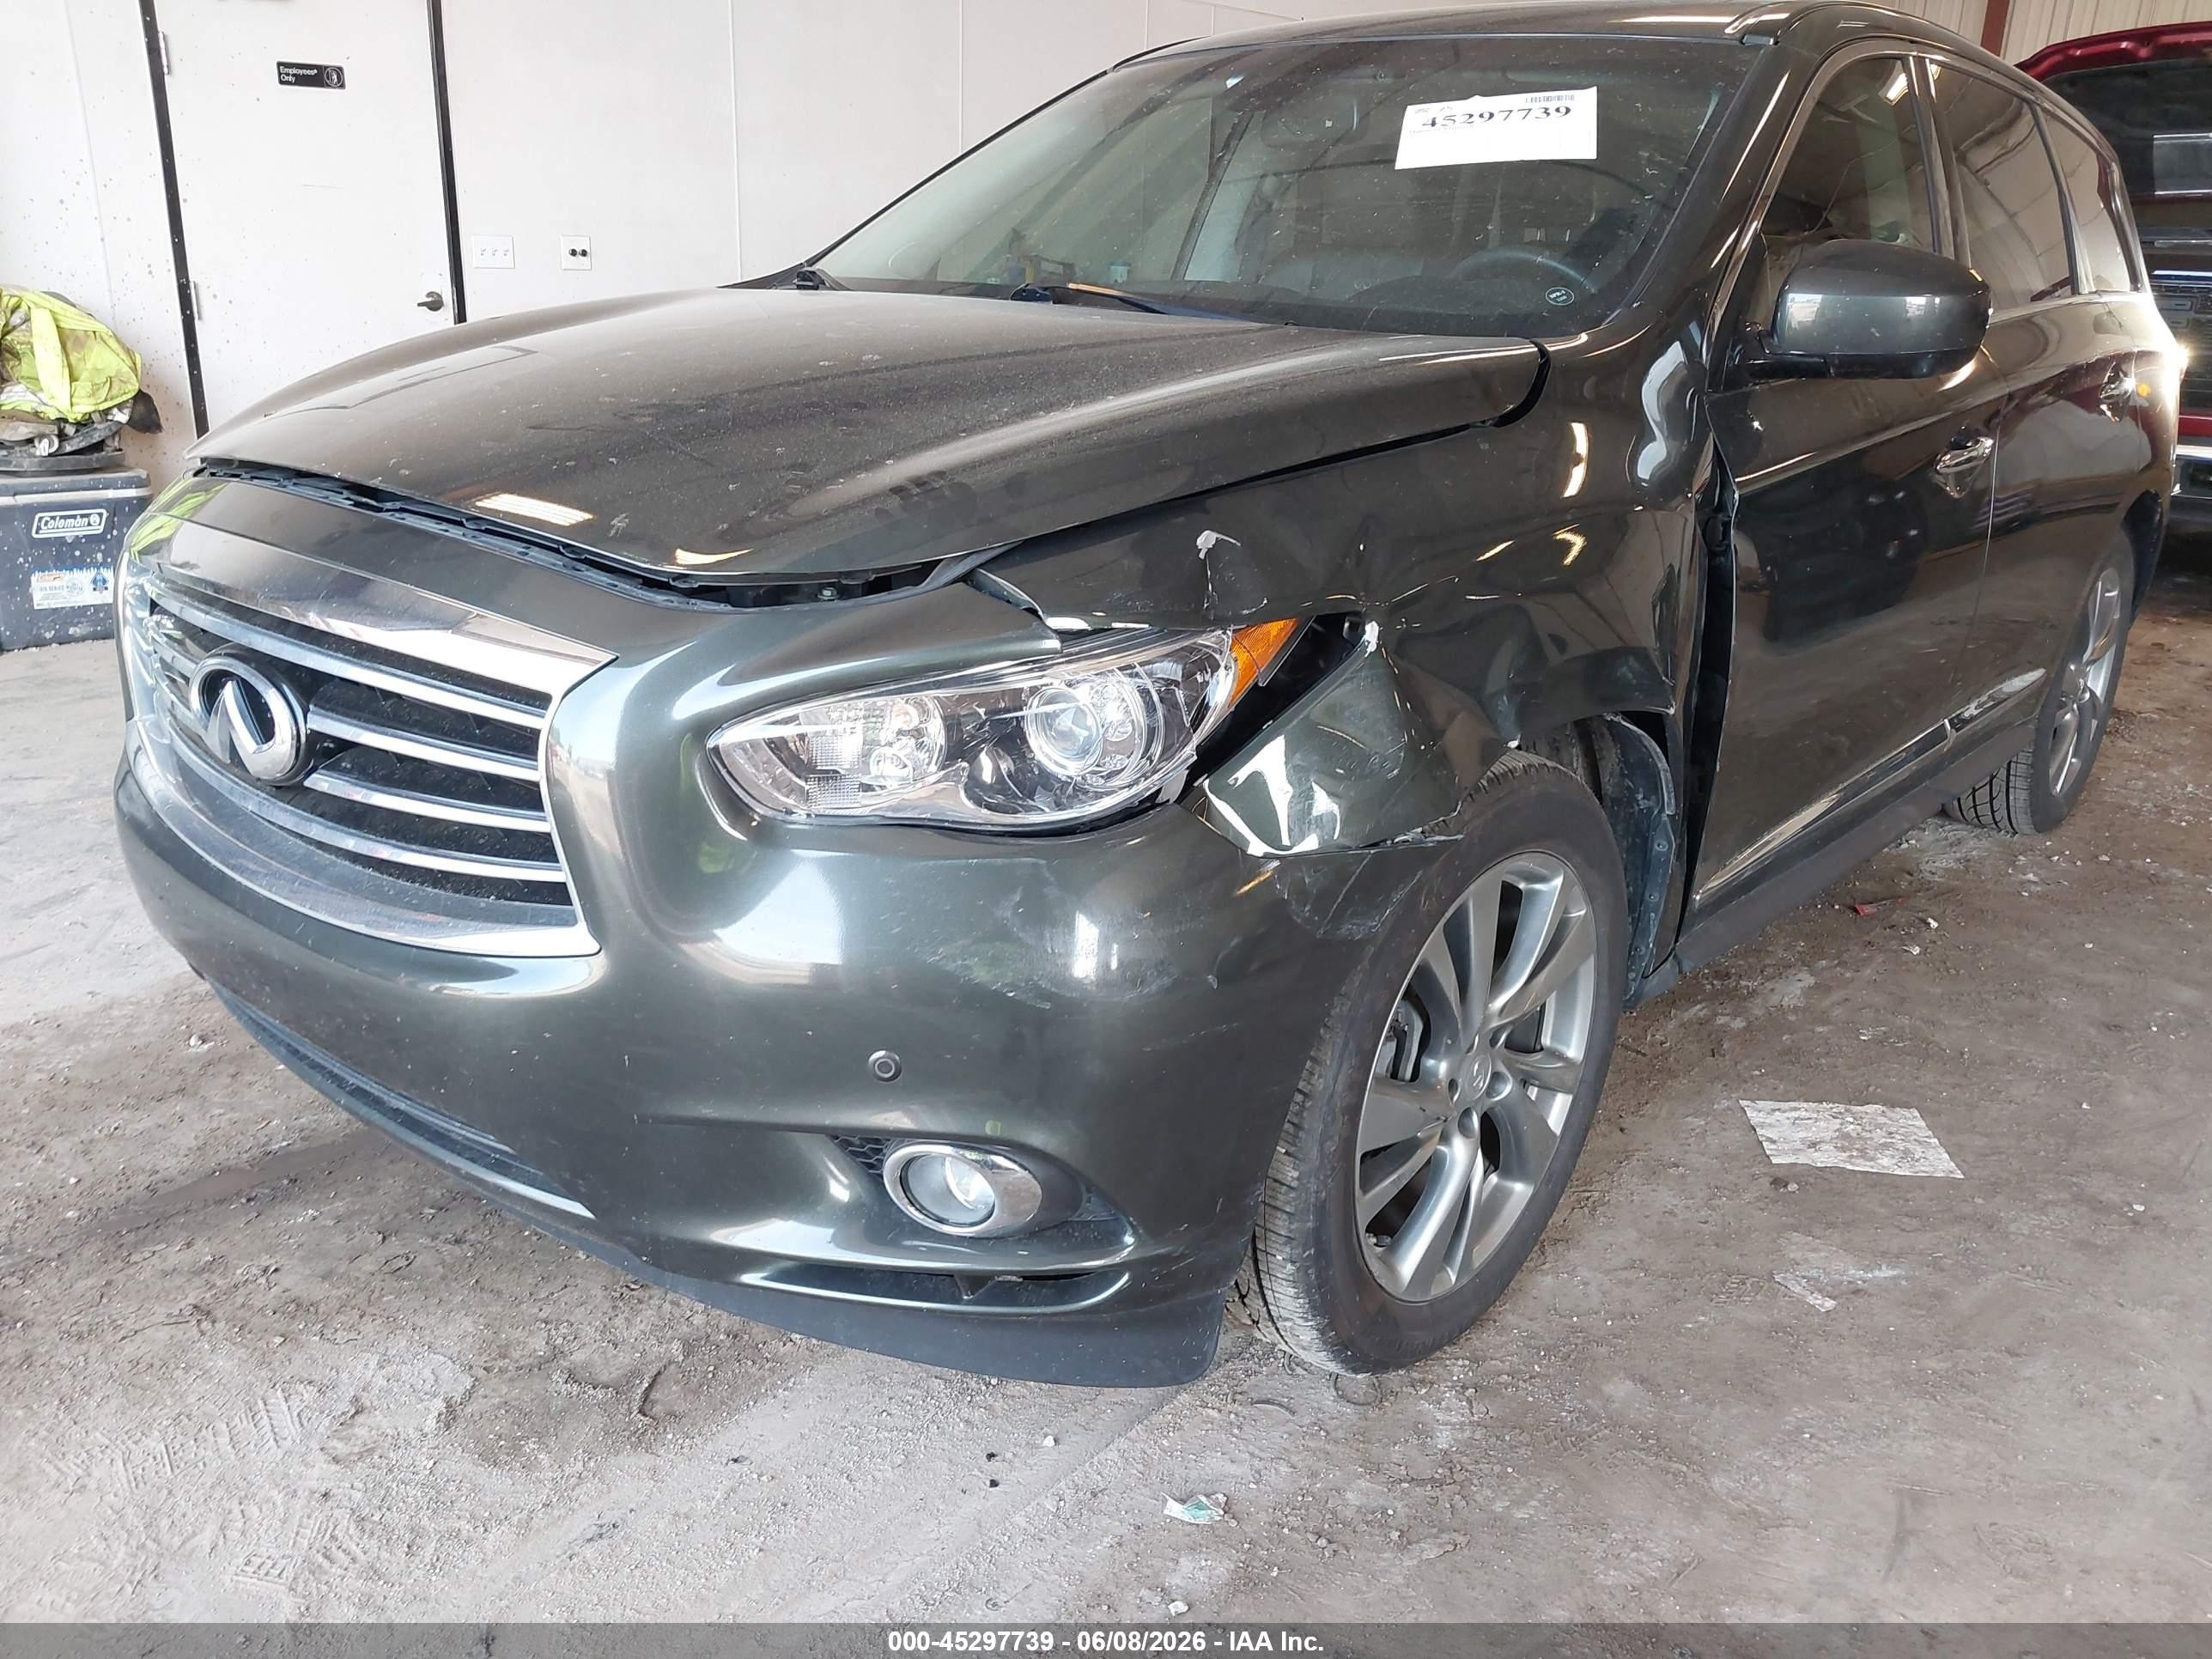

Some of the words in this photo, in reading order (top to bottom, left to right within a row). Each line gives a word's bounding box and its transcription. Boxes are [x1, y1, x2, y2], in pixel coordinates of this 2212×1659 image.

[280, 74, 295, 82] Only
[1422, 106, 1572, 128] 45297739
[40, 515, 88, 530] Coleman
